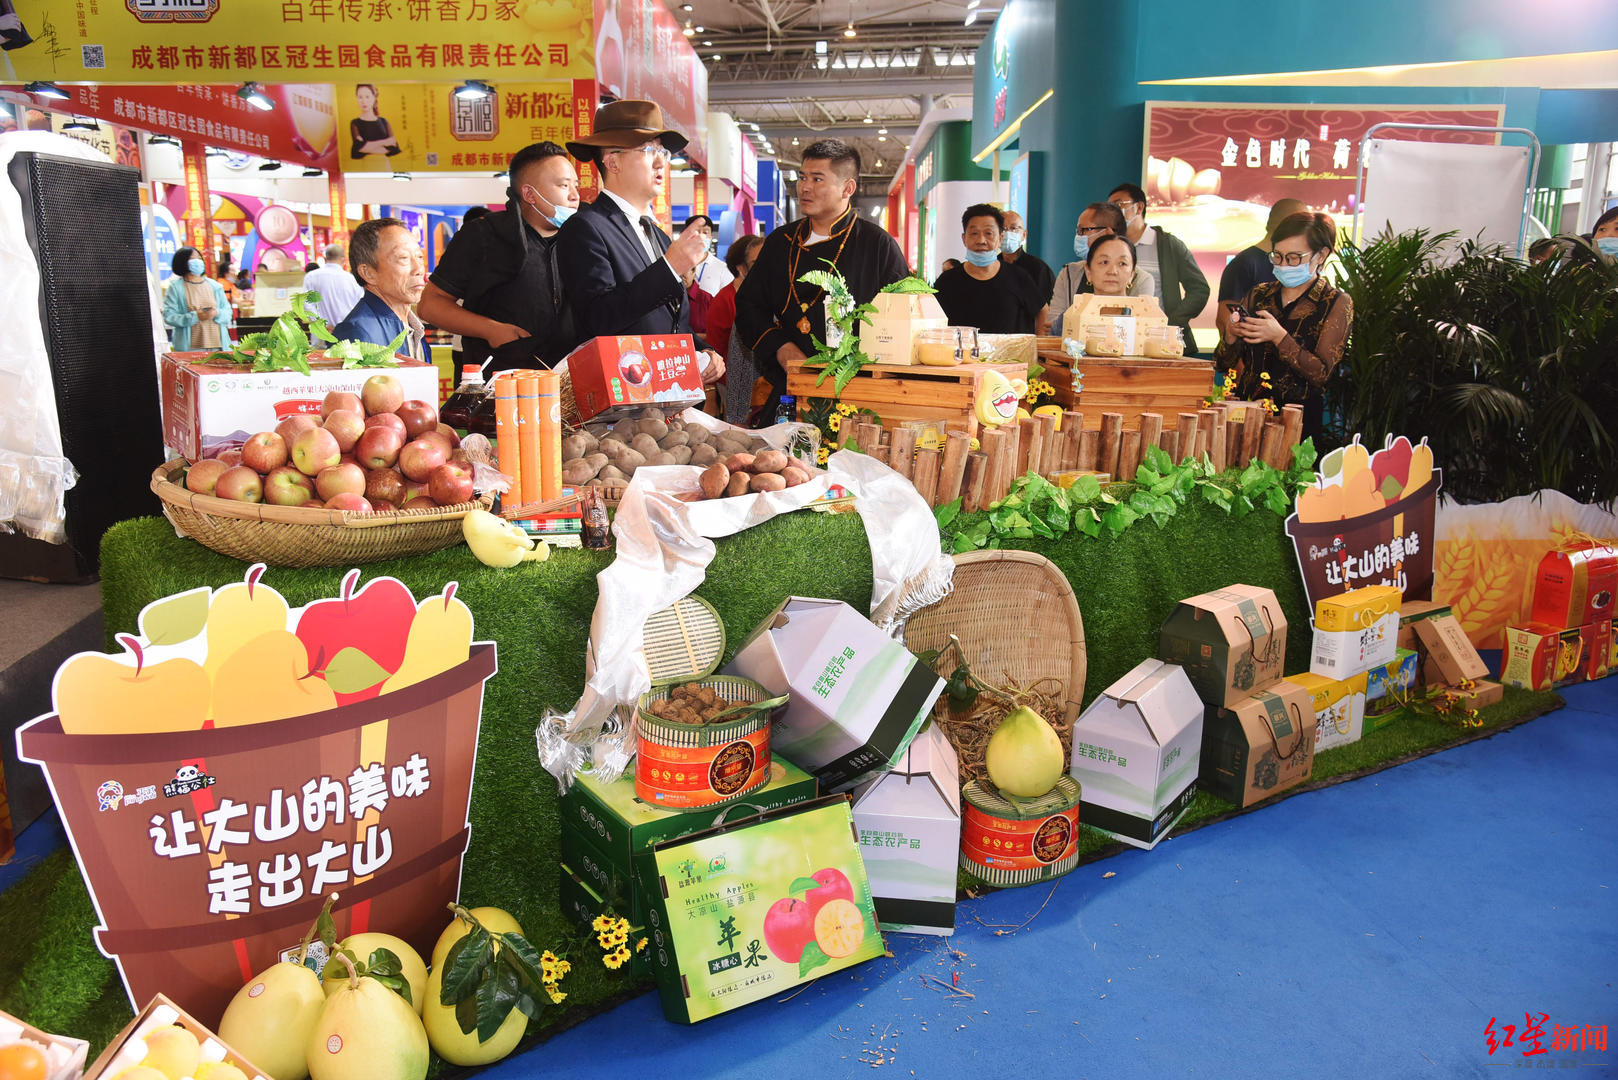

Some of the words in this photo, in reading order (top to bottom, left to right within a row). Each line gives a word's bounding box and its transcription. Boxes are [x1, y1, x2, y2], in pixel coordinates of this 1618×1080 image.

[131, 43, 569, 70] 成都市新都区冠生园食品有限责任公司
[112, 96, 271, 151] 成都市新都区冠生园食品有限责任公司
[1221, 136, 1311, 169] 金色时代
[1325, 531, 1420, 585] 让大山的美味
[817, 646, 856, 699] 生态农产品
[1079, 747, 1128, 768] 生态农产品
[149, 752, 432, 859] 让大山的美味
[860, 835, 921, 849] 生态农产品
[206, 825, 394, 914] 走出大山
[685, 891, 720, 905] Healthy
[727, 882, 754, 895] Apples
[688, 903, 718, 921] 大凉山
[717, 915, 768, 968] 苹果
[712, 956, 738, 971] 冰糖心
